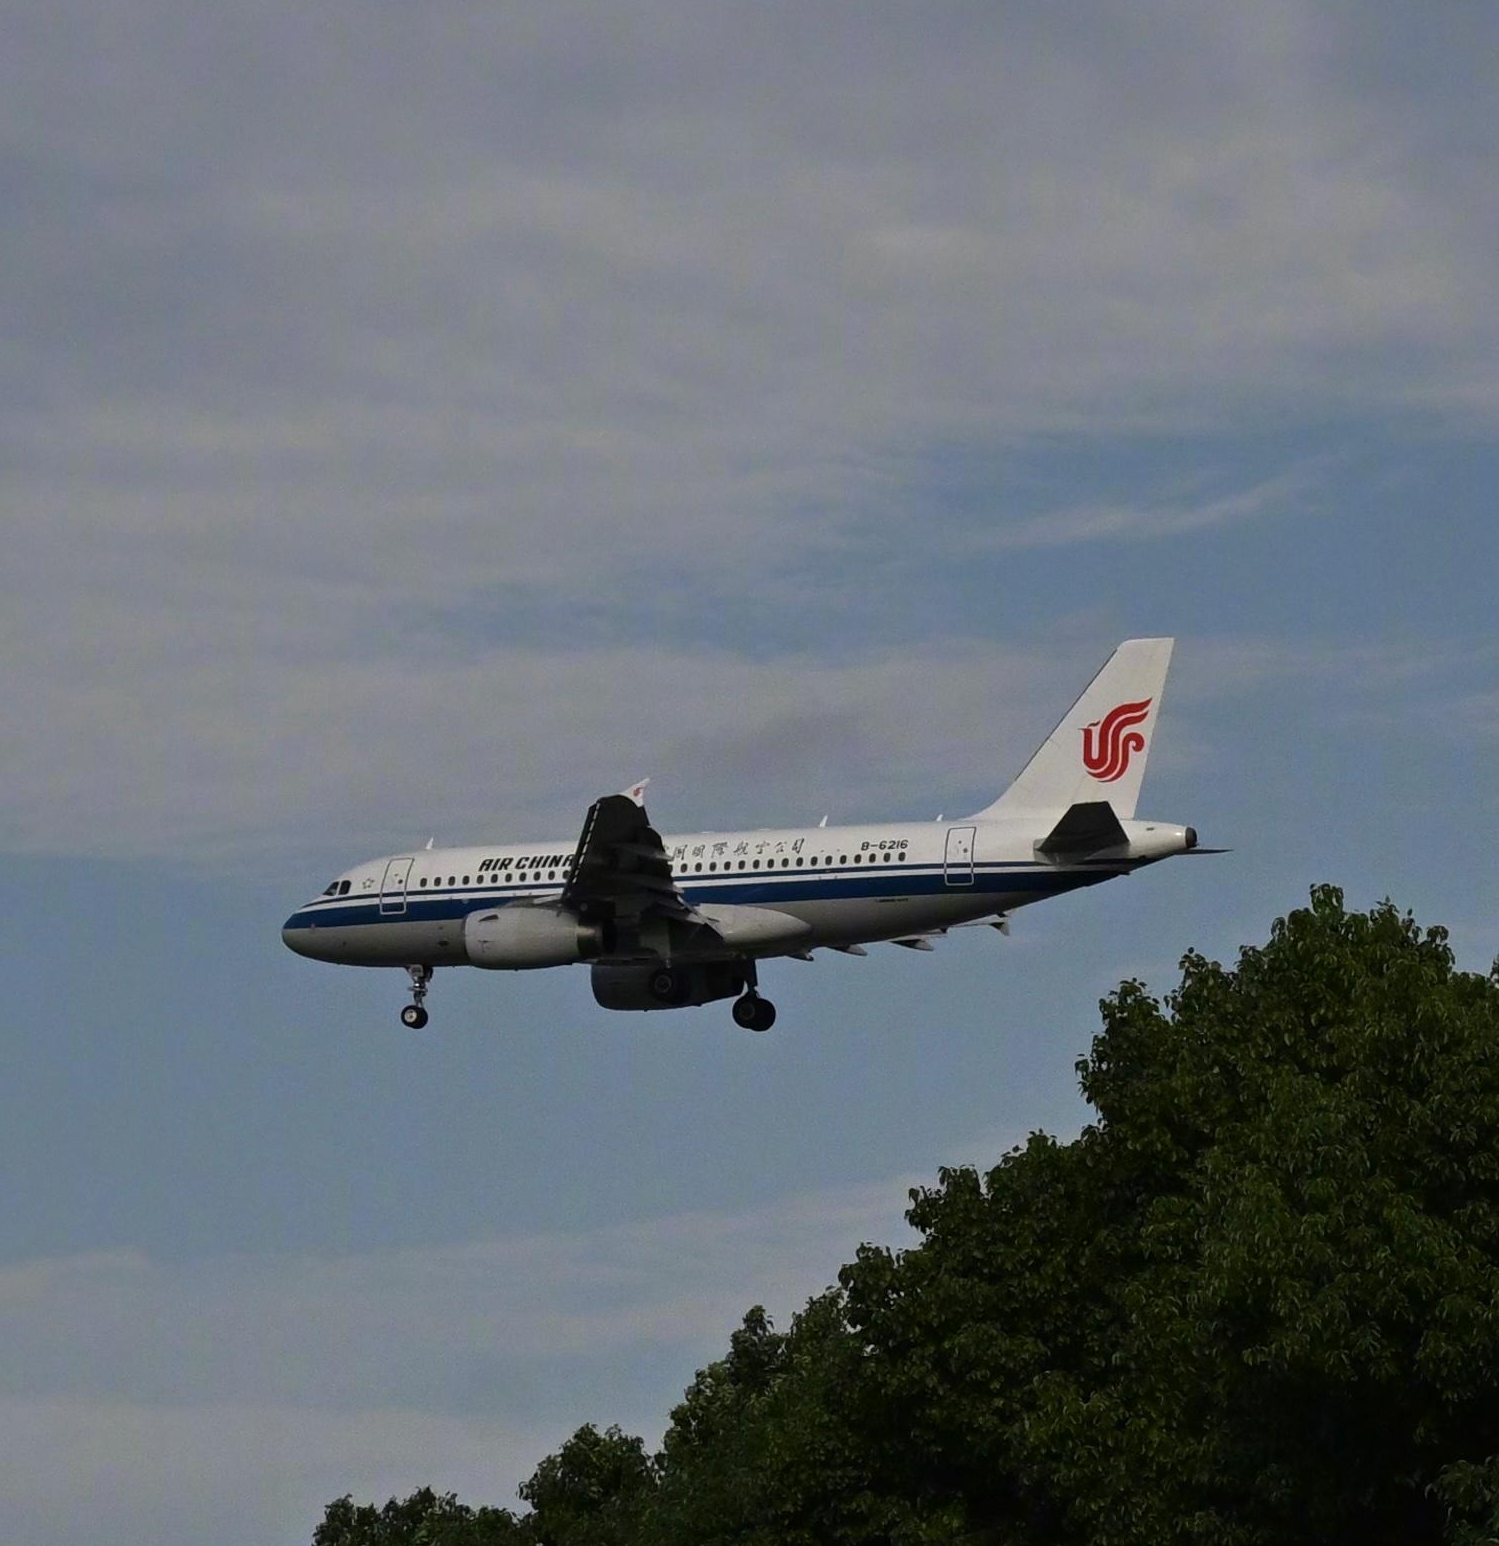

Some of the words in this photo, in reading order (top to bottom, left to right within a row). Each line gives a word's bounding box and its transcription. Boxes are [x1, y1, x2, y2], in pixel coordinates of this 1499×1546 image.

[663, 838, 805, 862] 国国际航空公司
[861, 839, 909, 851] B-6216
[478, 857, 514, 872] AIR
[515, 854, 575, 870] CHINA
